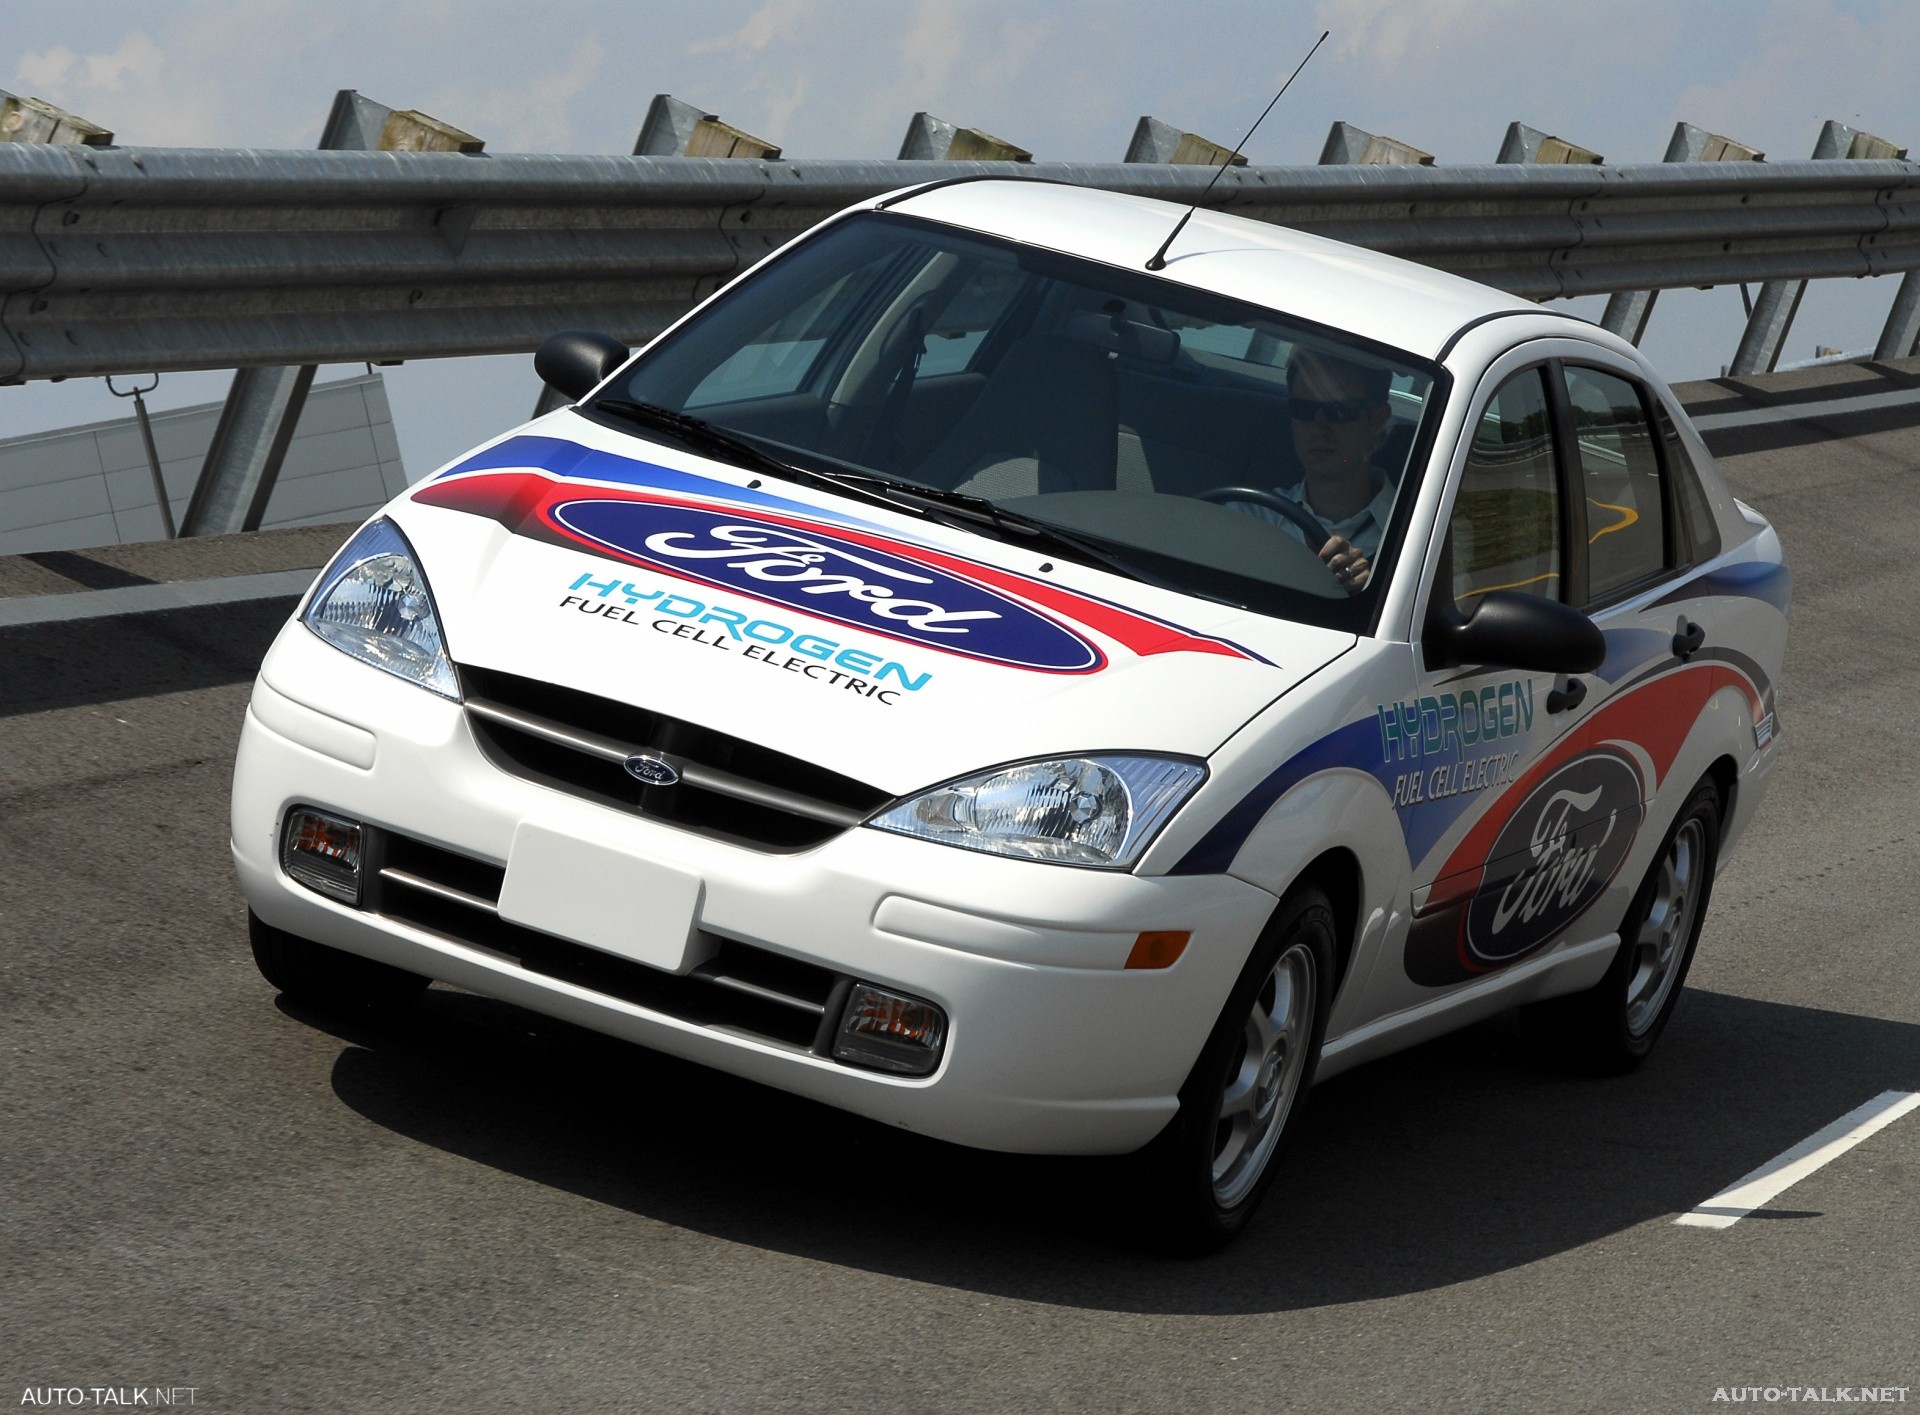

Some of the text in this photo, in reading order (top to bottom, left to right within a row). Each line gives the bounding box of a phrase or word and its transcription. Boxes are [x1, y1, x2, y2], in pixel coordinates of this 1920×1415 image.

[568, 573, 933, 691] HYDROGEN
[645, 525, 1002, 633] Ford
[559, 595, 901, 705] FUEL CELL ELECTRIC
[634, 760, 666, 780] Ford
[1377, 679, 1534, 763] HYDROGEN
[1392, 751, 1519, 809] FUEL CELL ELECTRIC
[1491, 785, 1617, 934] Ford
